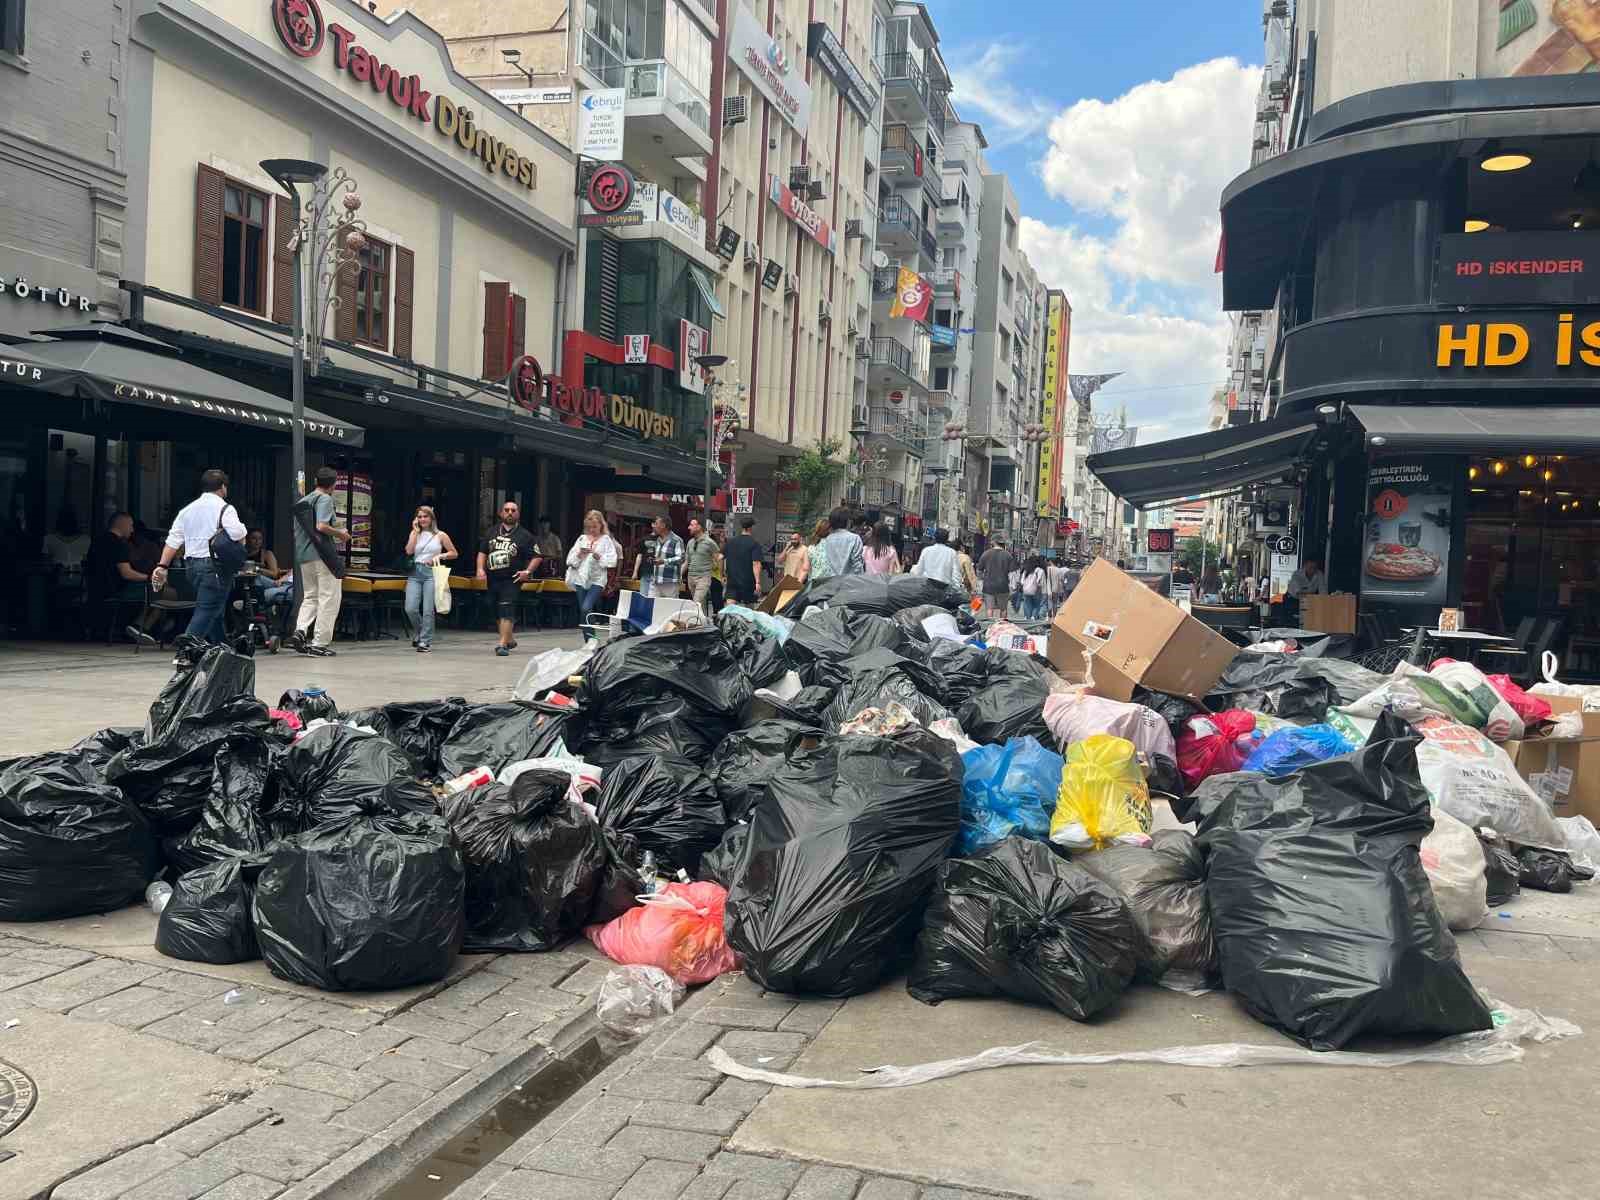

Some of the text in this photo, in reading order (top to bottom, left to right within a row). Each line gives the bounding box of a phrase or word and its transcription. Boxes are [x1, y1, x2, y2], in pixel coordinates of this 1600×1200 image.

[329, 23, 537, 191] Tavuk Dünyası
[1456, 261, 1483, 277] HD
[1436, 323, 1530, 367] HD
[551, 381, 675, 440] Tavuk Dünyası
